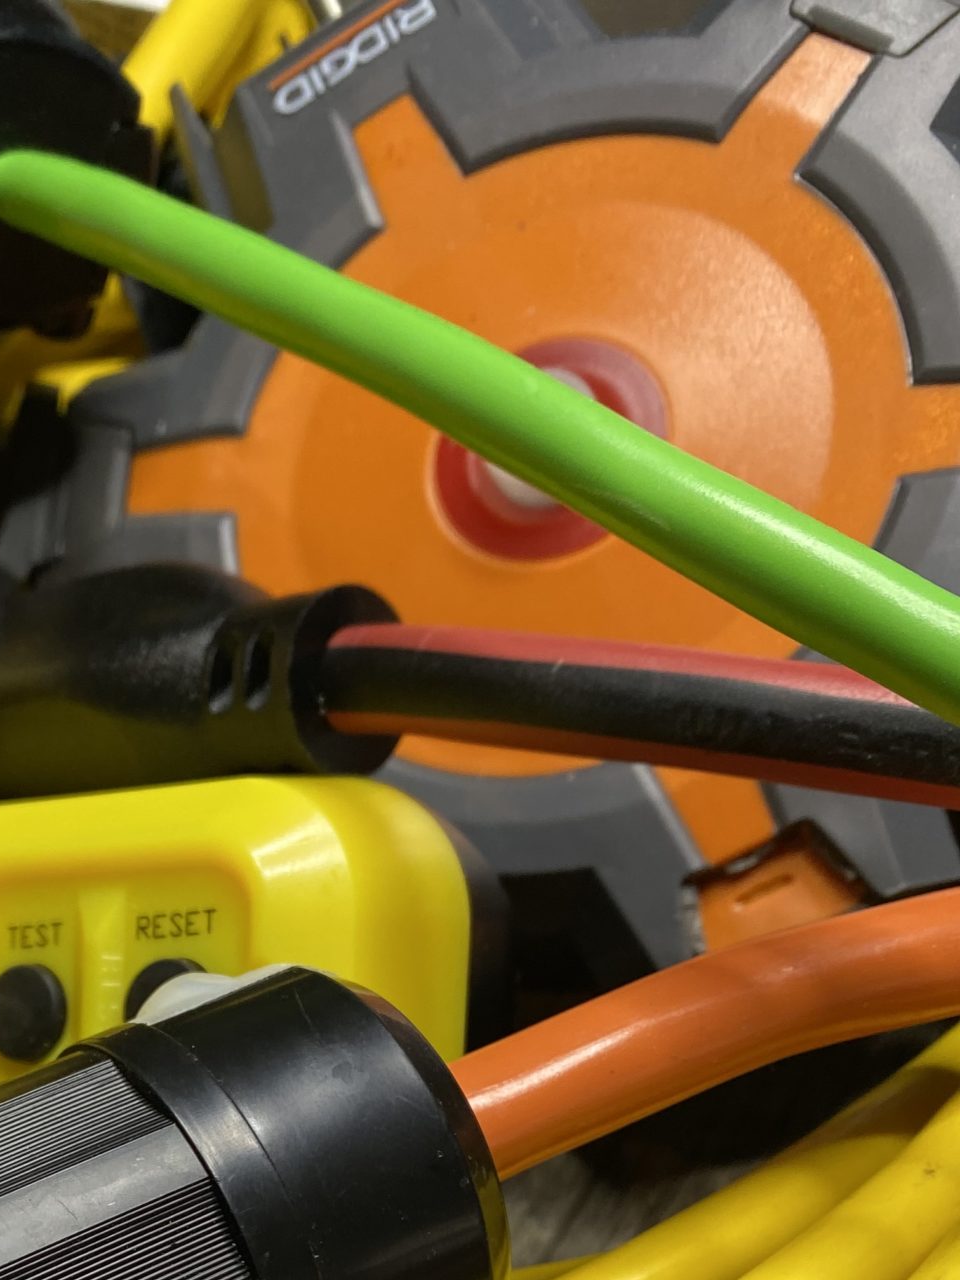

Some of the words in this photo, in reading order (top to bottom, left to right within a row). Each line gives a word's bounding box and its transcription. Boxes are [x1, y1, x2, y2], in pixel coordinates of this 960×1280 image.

[273, 0, 437, 115] RIDGID
[8, 921, 63, 951] TEST
[135, 908, 218, 941] RESET
